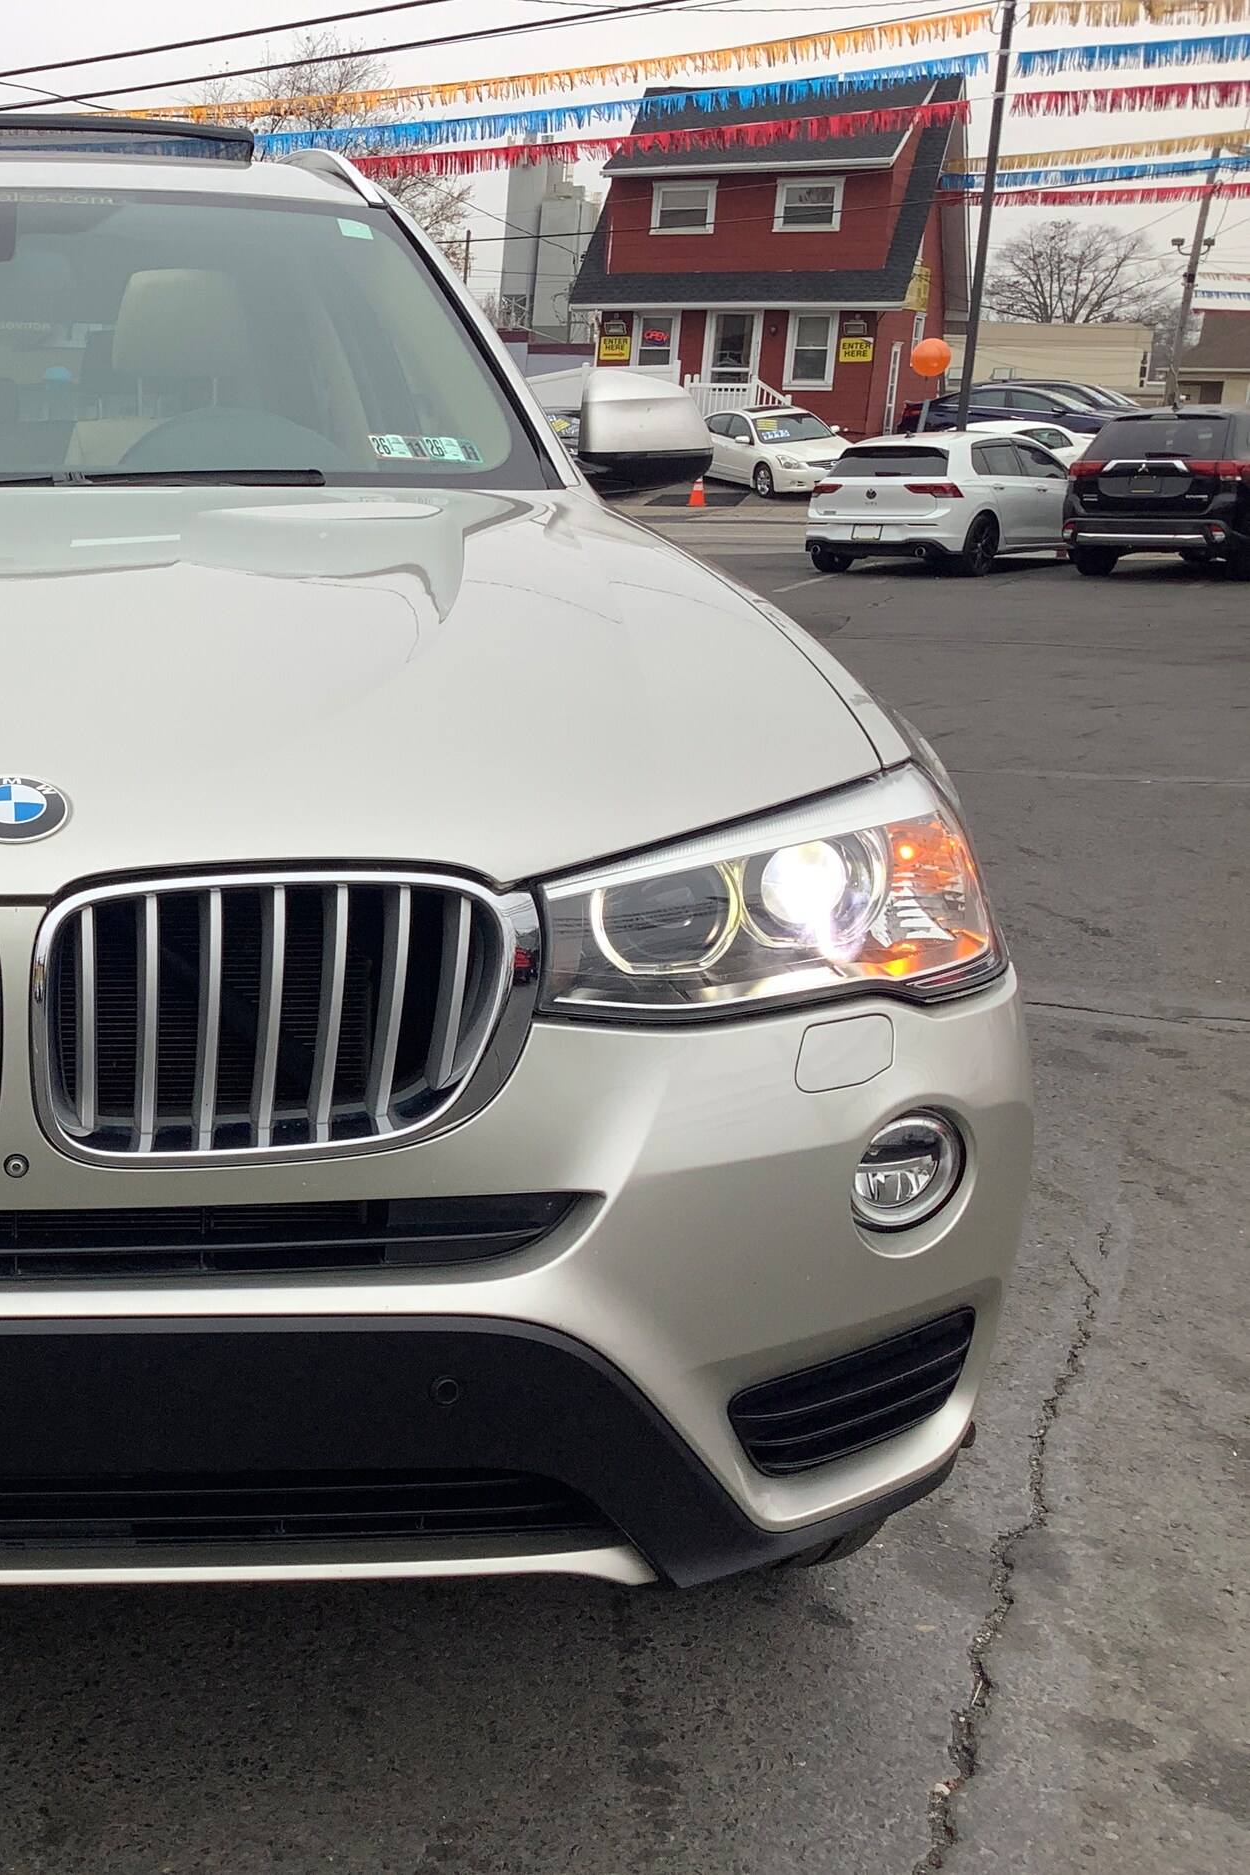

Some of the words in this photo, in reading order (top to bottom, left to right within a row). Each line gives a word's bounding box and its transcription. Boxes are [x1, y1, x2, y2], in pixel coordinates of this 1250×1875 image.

[371, 437, 392, 455] 26
[407, 441, 427, 458] 11
[425, 438, 445, 457] 26
[461, 445, 480, 461] 11
